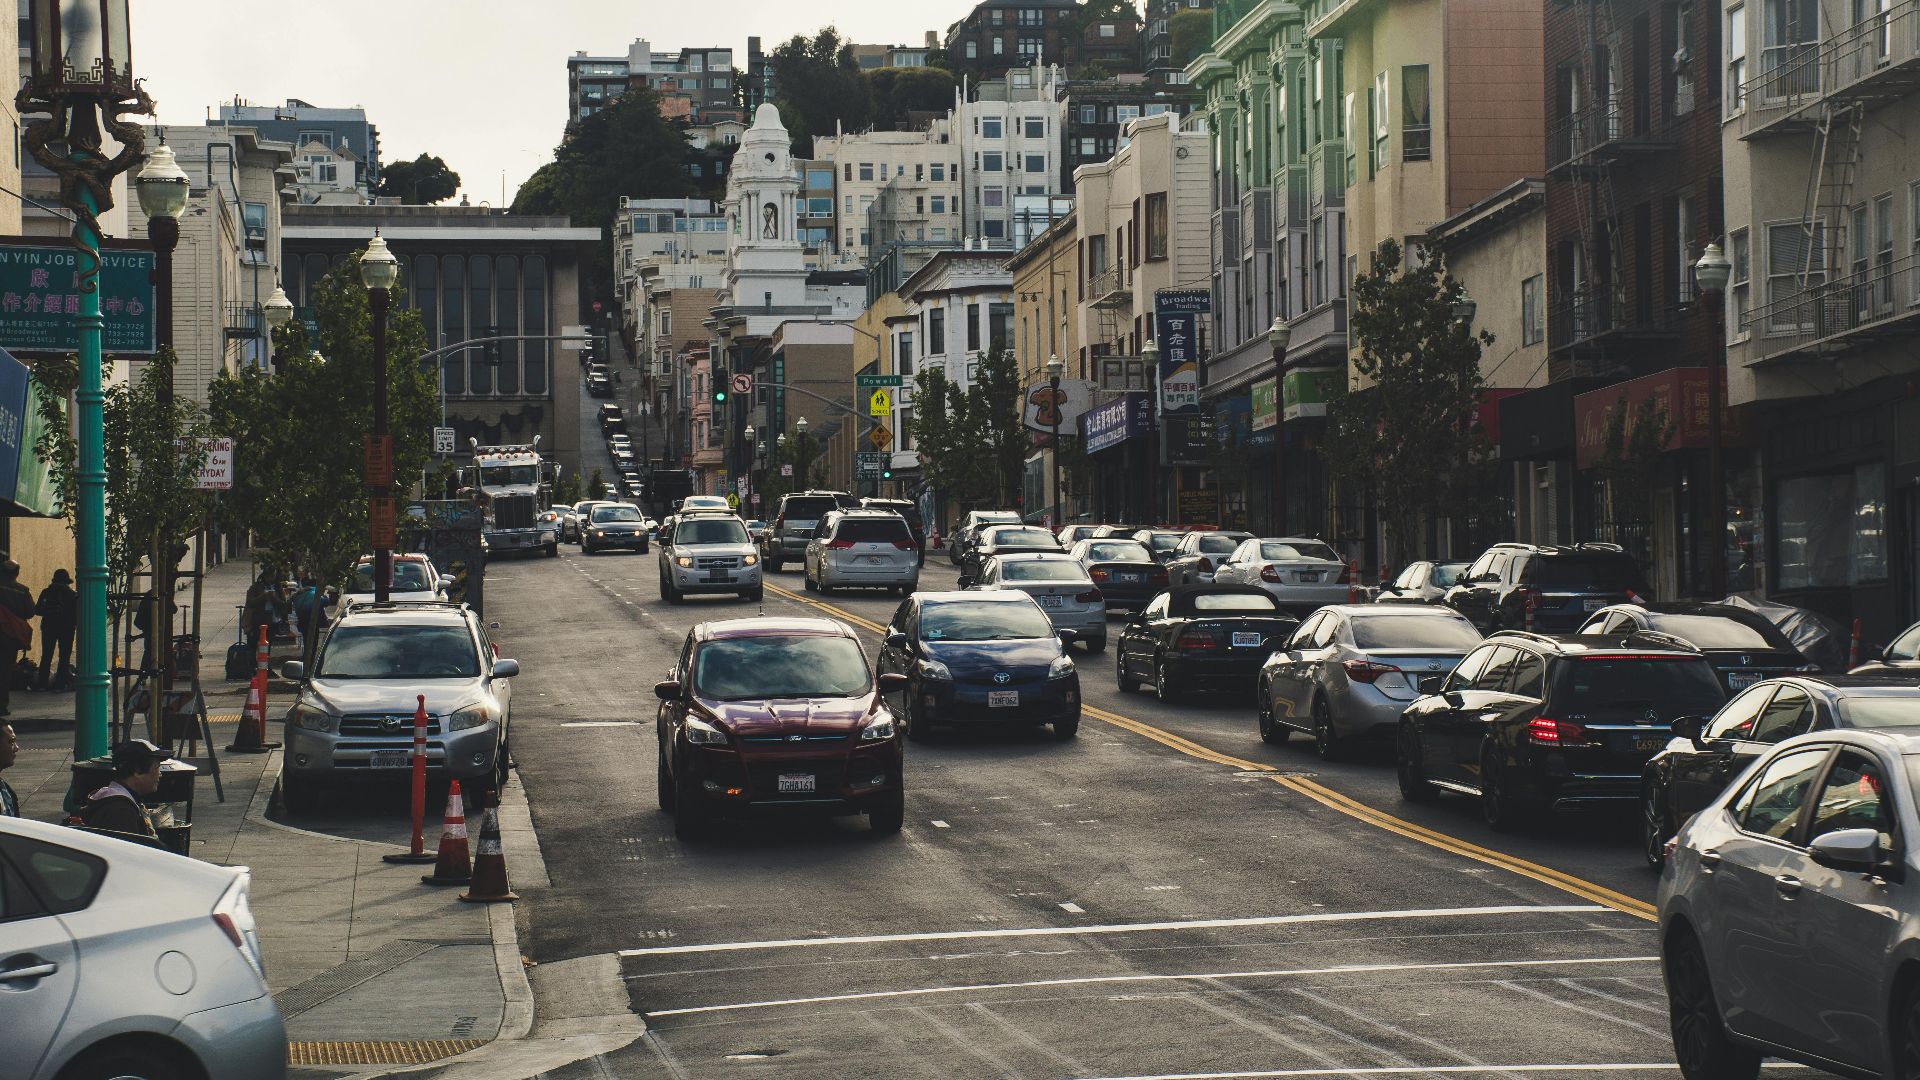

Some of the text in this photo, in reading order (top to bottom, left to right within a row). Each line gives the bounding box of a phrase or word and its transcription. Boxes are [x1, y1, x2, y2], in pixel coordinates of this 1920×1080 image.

[14, 253, 40, 265] YIN
[45, 255, 75, 266] JOB
[863, 376, 898, 385] Powell
[438, 442, 453, 451] 35
